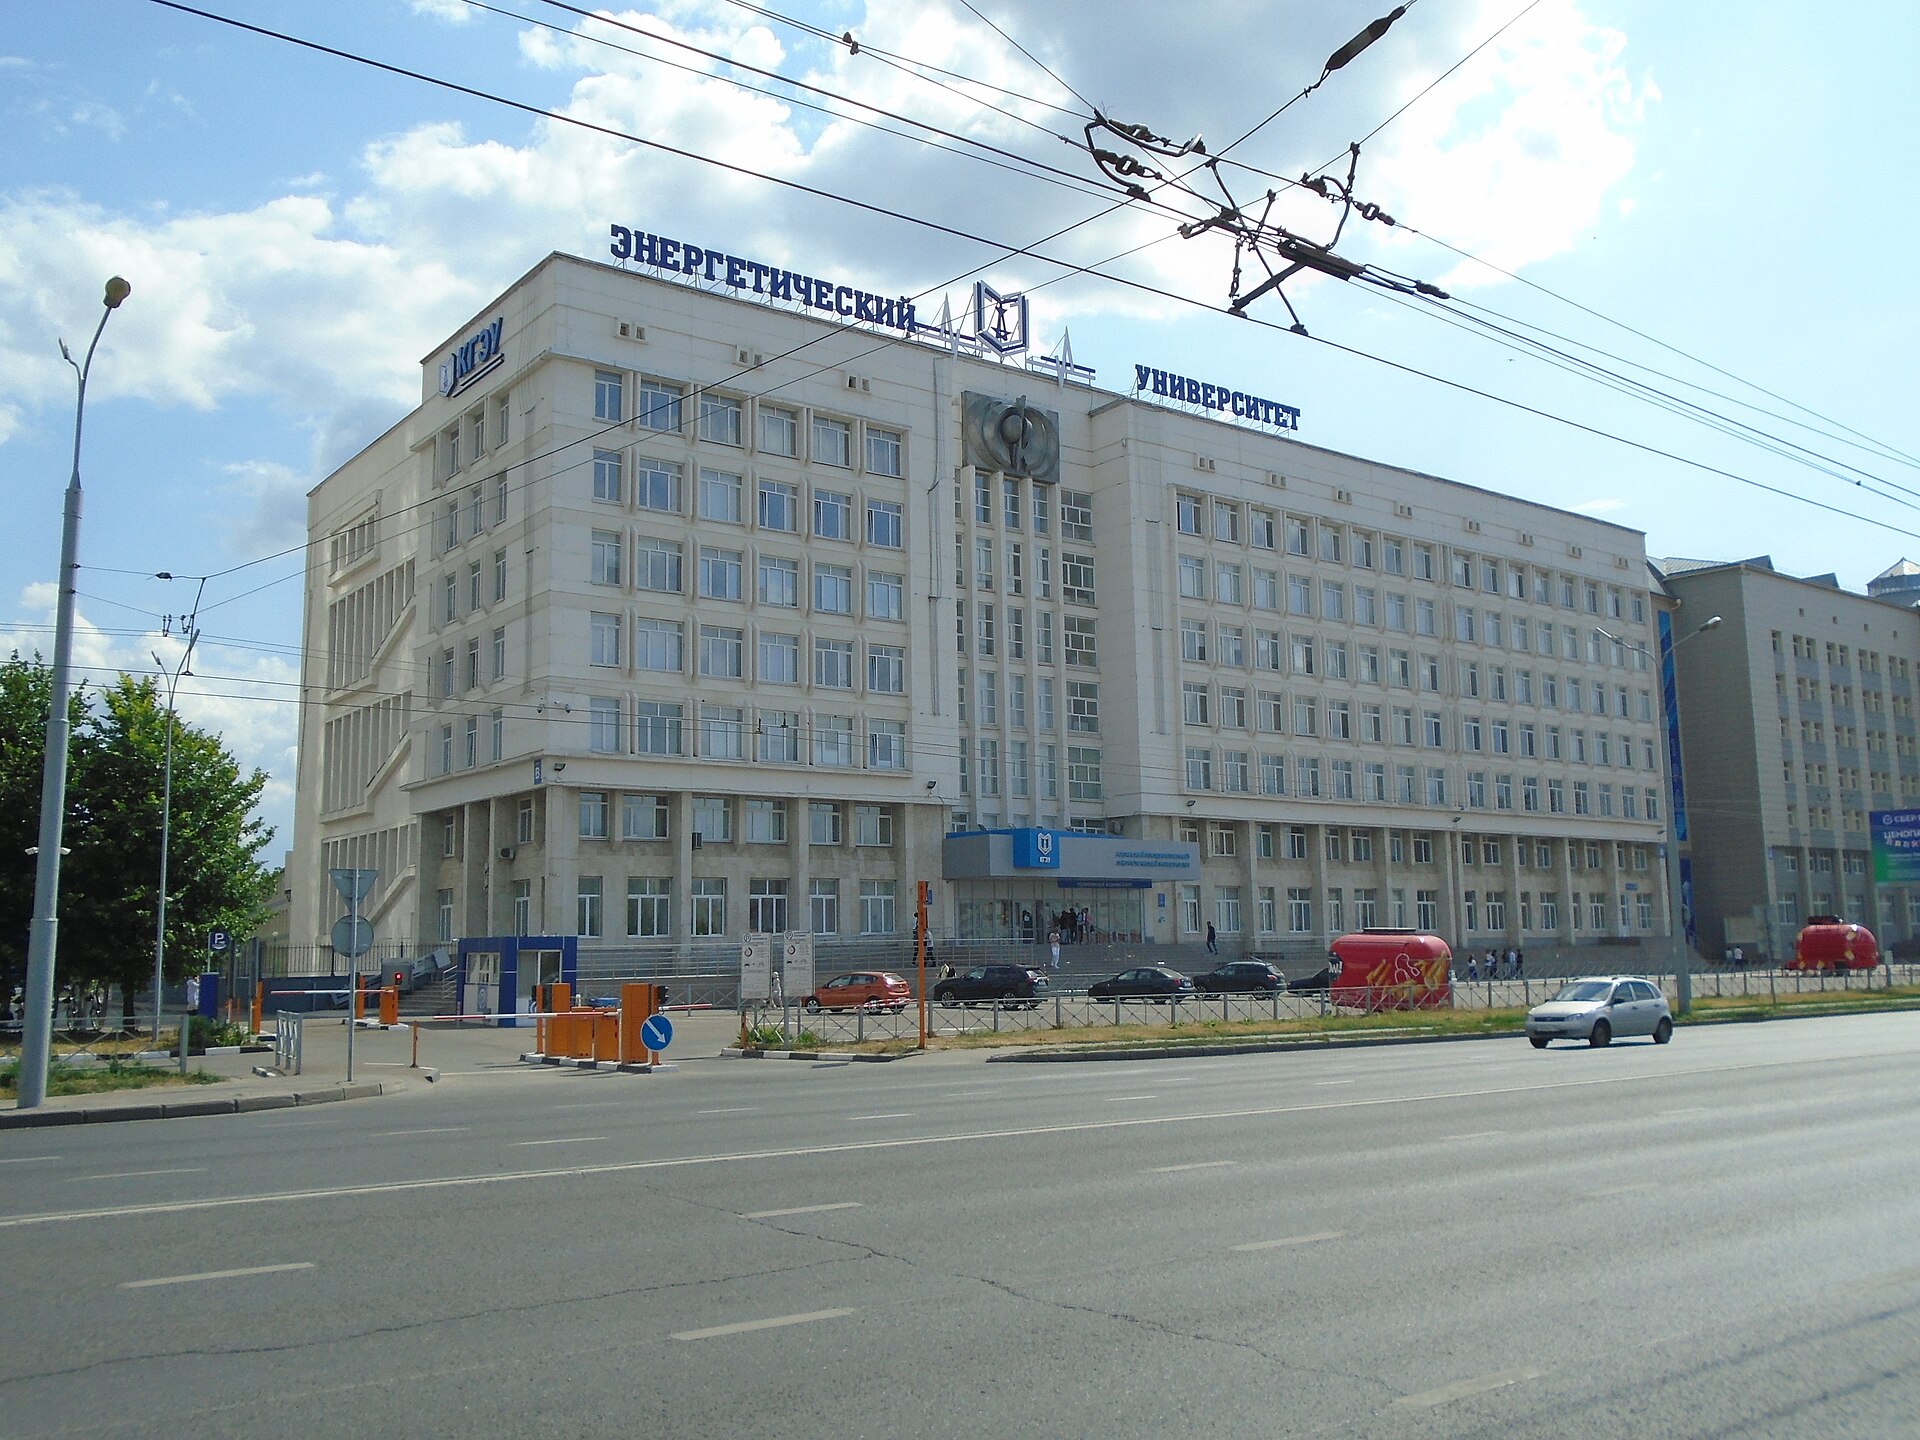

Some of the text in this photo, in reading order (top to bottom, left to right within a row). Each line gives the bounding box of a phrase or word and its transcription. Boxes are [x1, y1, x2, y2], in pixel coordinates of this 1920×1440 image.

[610, 224, 916, 333] ЭНЕРГЕТИЧЕСКИЙ
[456, 317, 503, 379] КГЭУ
[1135, 364, 1300, 430] УНИВЕРСИТЕТ
